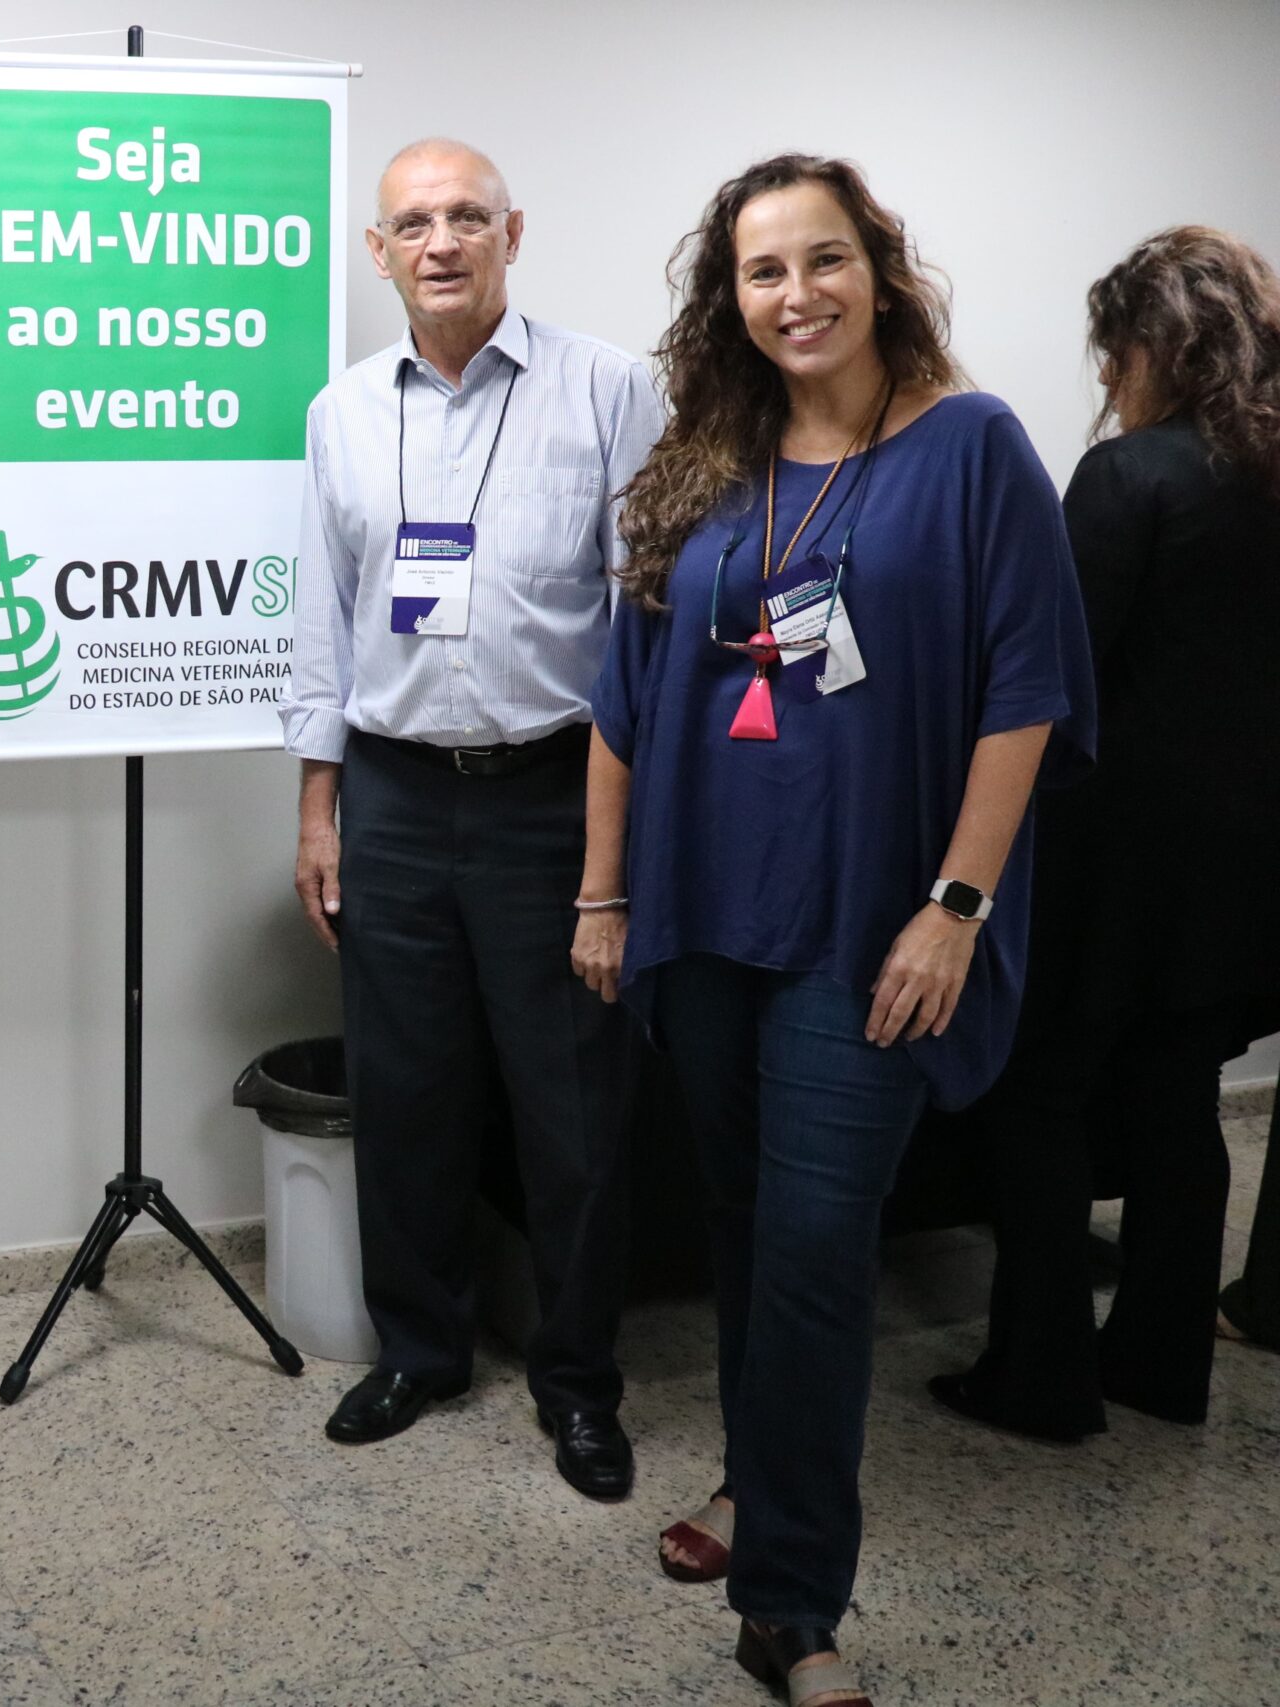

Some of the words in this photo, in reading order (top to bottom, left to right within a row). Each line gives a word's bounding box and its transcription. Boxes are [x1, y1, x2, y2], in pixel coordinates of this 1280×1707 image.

[76, 126, 201, 196] Seja
[7, 306, 78, 347] ao
[98, 306, 267, 348] nosso
[35, 380, 240, 429] evento
[54, 555, 298, 621] CRMVS
[783, 580, 813, 599] ENCONTRO
[77, 641, 177, 659] CONSELHO
[183, 638, 270, 656] REGIONAL
[83, 667, 175, 684] MEDICINA
[181, 659, 292, 681] VETERINÁRIA
[70, 693, 96, 710] DO
[103, 691, 173, 709] ESTADO
[180, 690, 201, 706] DE
[207, 685, 244, 705] SÃO
[250, 687, 283, 703] PAU
